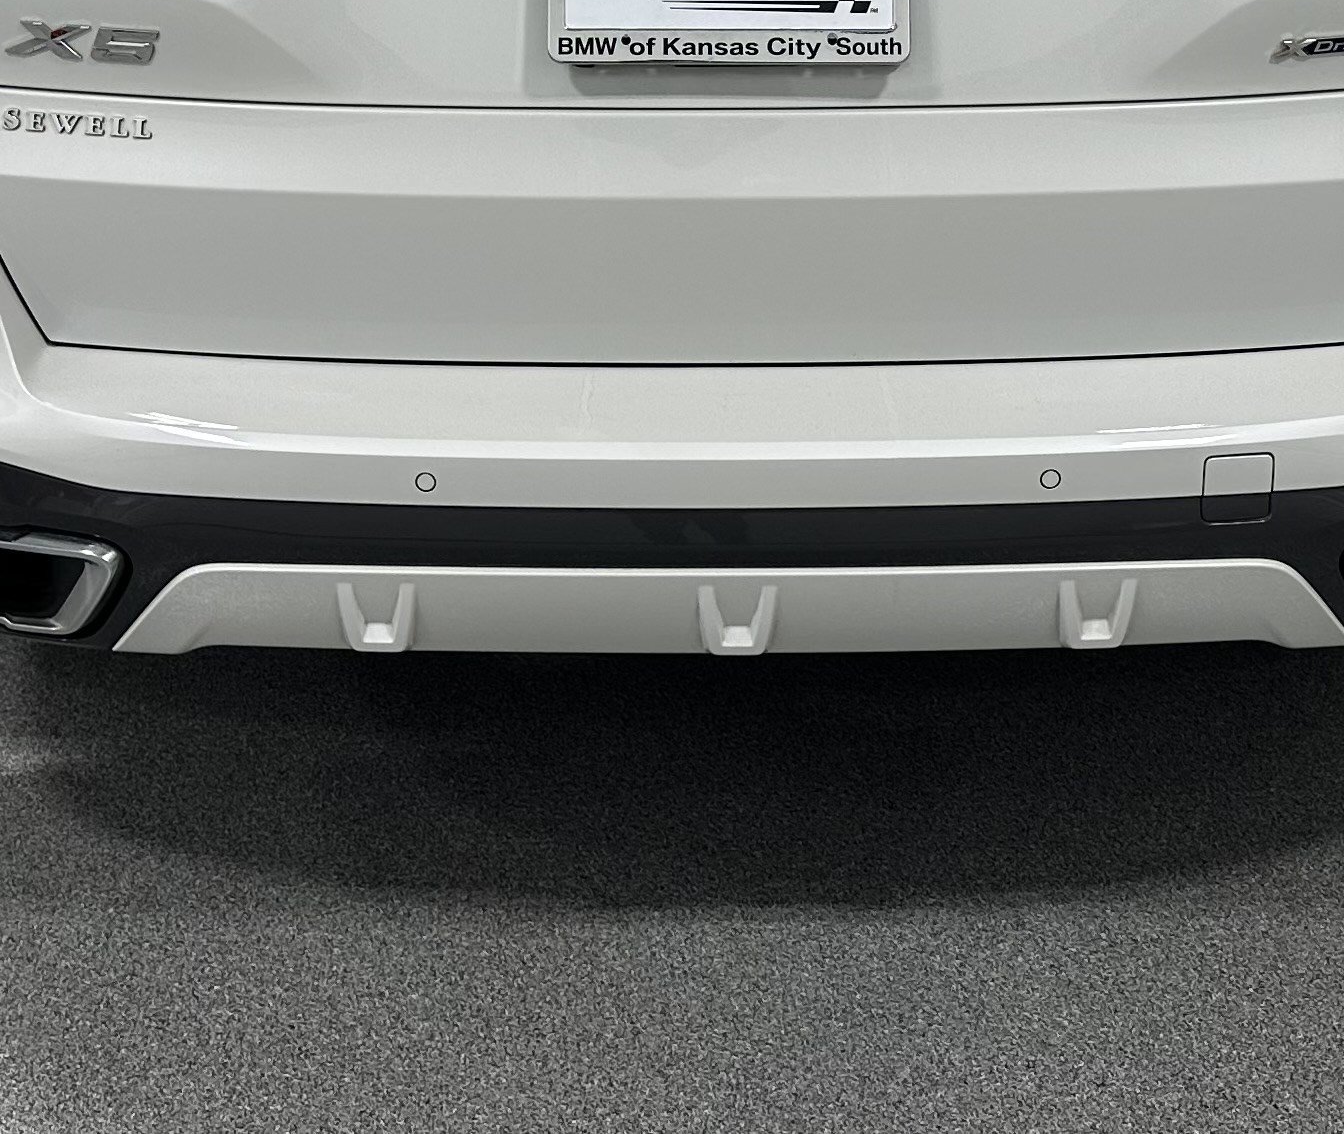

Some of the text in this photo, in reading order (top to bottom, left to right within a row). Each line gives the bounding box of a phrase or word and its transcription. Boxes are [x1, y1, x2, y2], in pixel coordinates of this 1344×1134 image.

[4, 19, 160, 66] X5
[558, 36, 903, 60] BMW of Kansas City South
[2, 107, 154, 139] SEWELL
